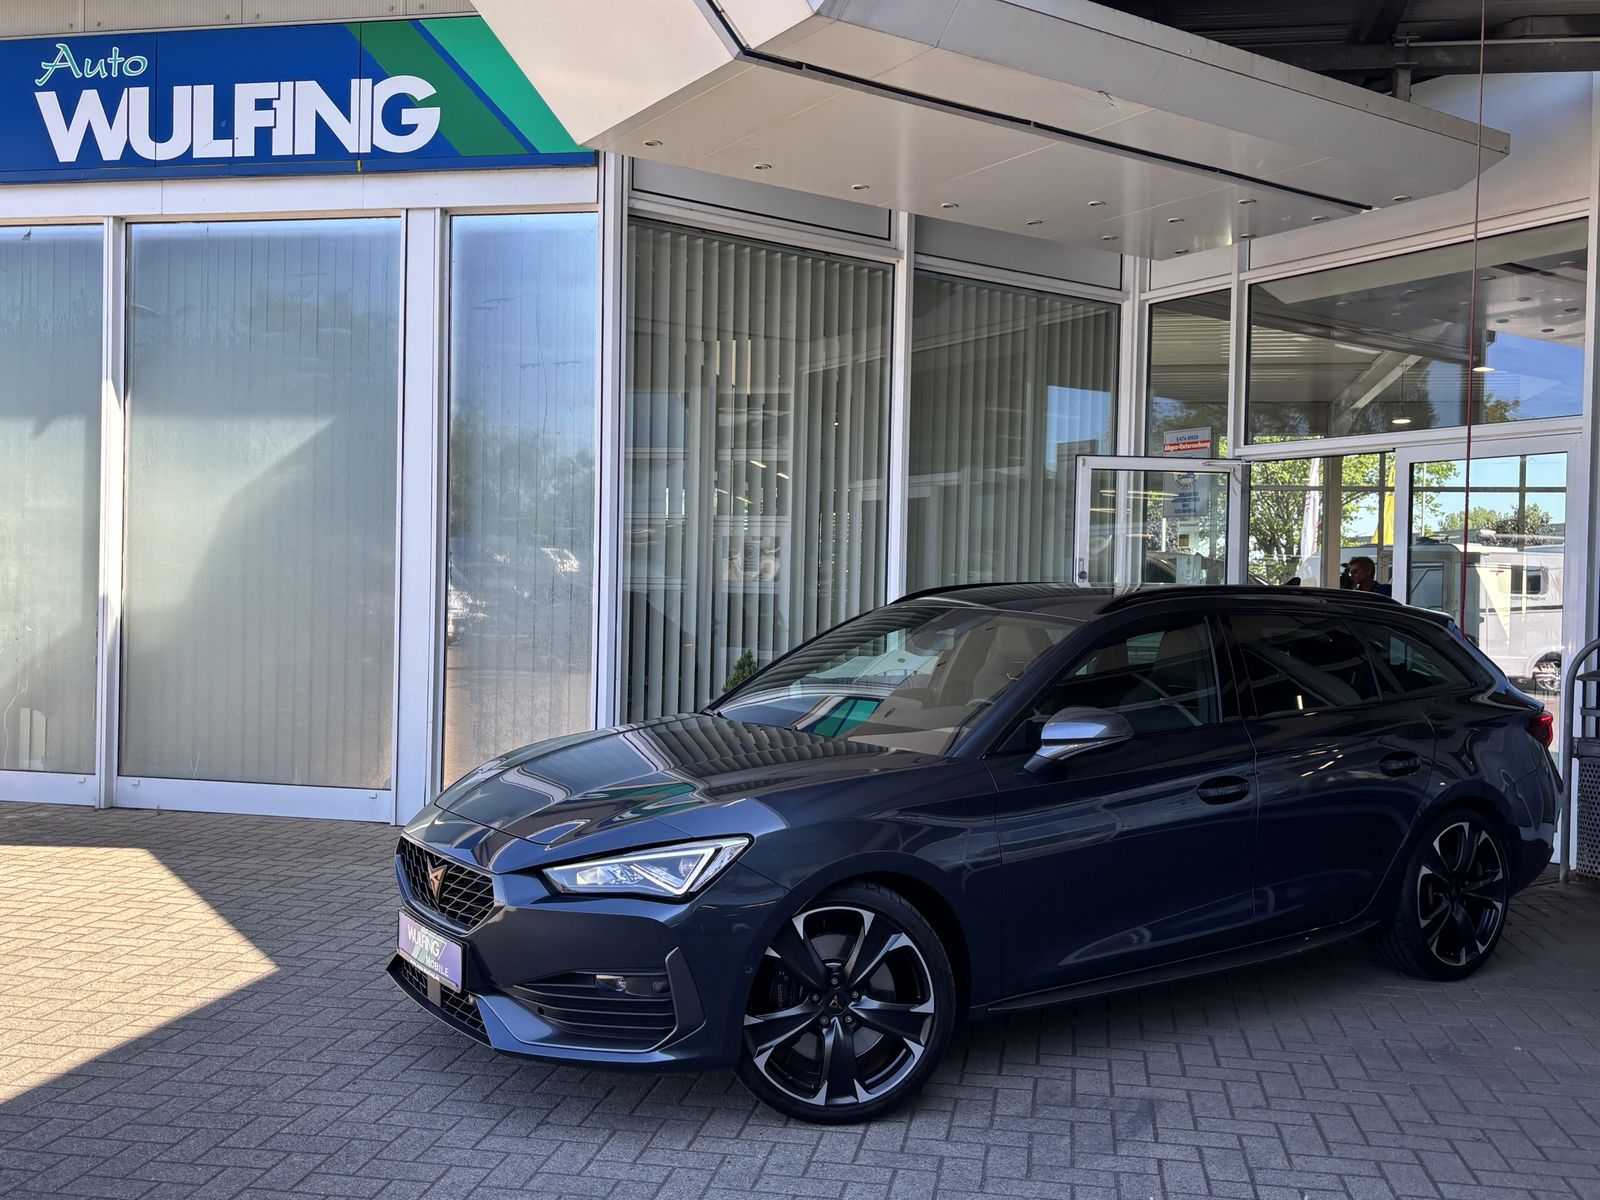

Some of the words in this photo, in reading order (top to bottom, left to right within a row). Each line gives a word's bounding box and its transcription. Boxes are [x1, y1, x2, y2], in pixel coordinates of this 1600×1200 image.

[35, 43, 148, 86] Auto
[34, 75, 441, 162] WULFING
[407, 924, 440, 957] WULFING
